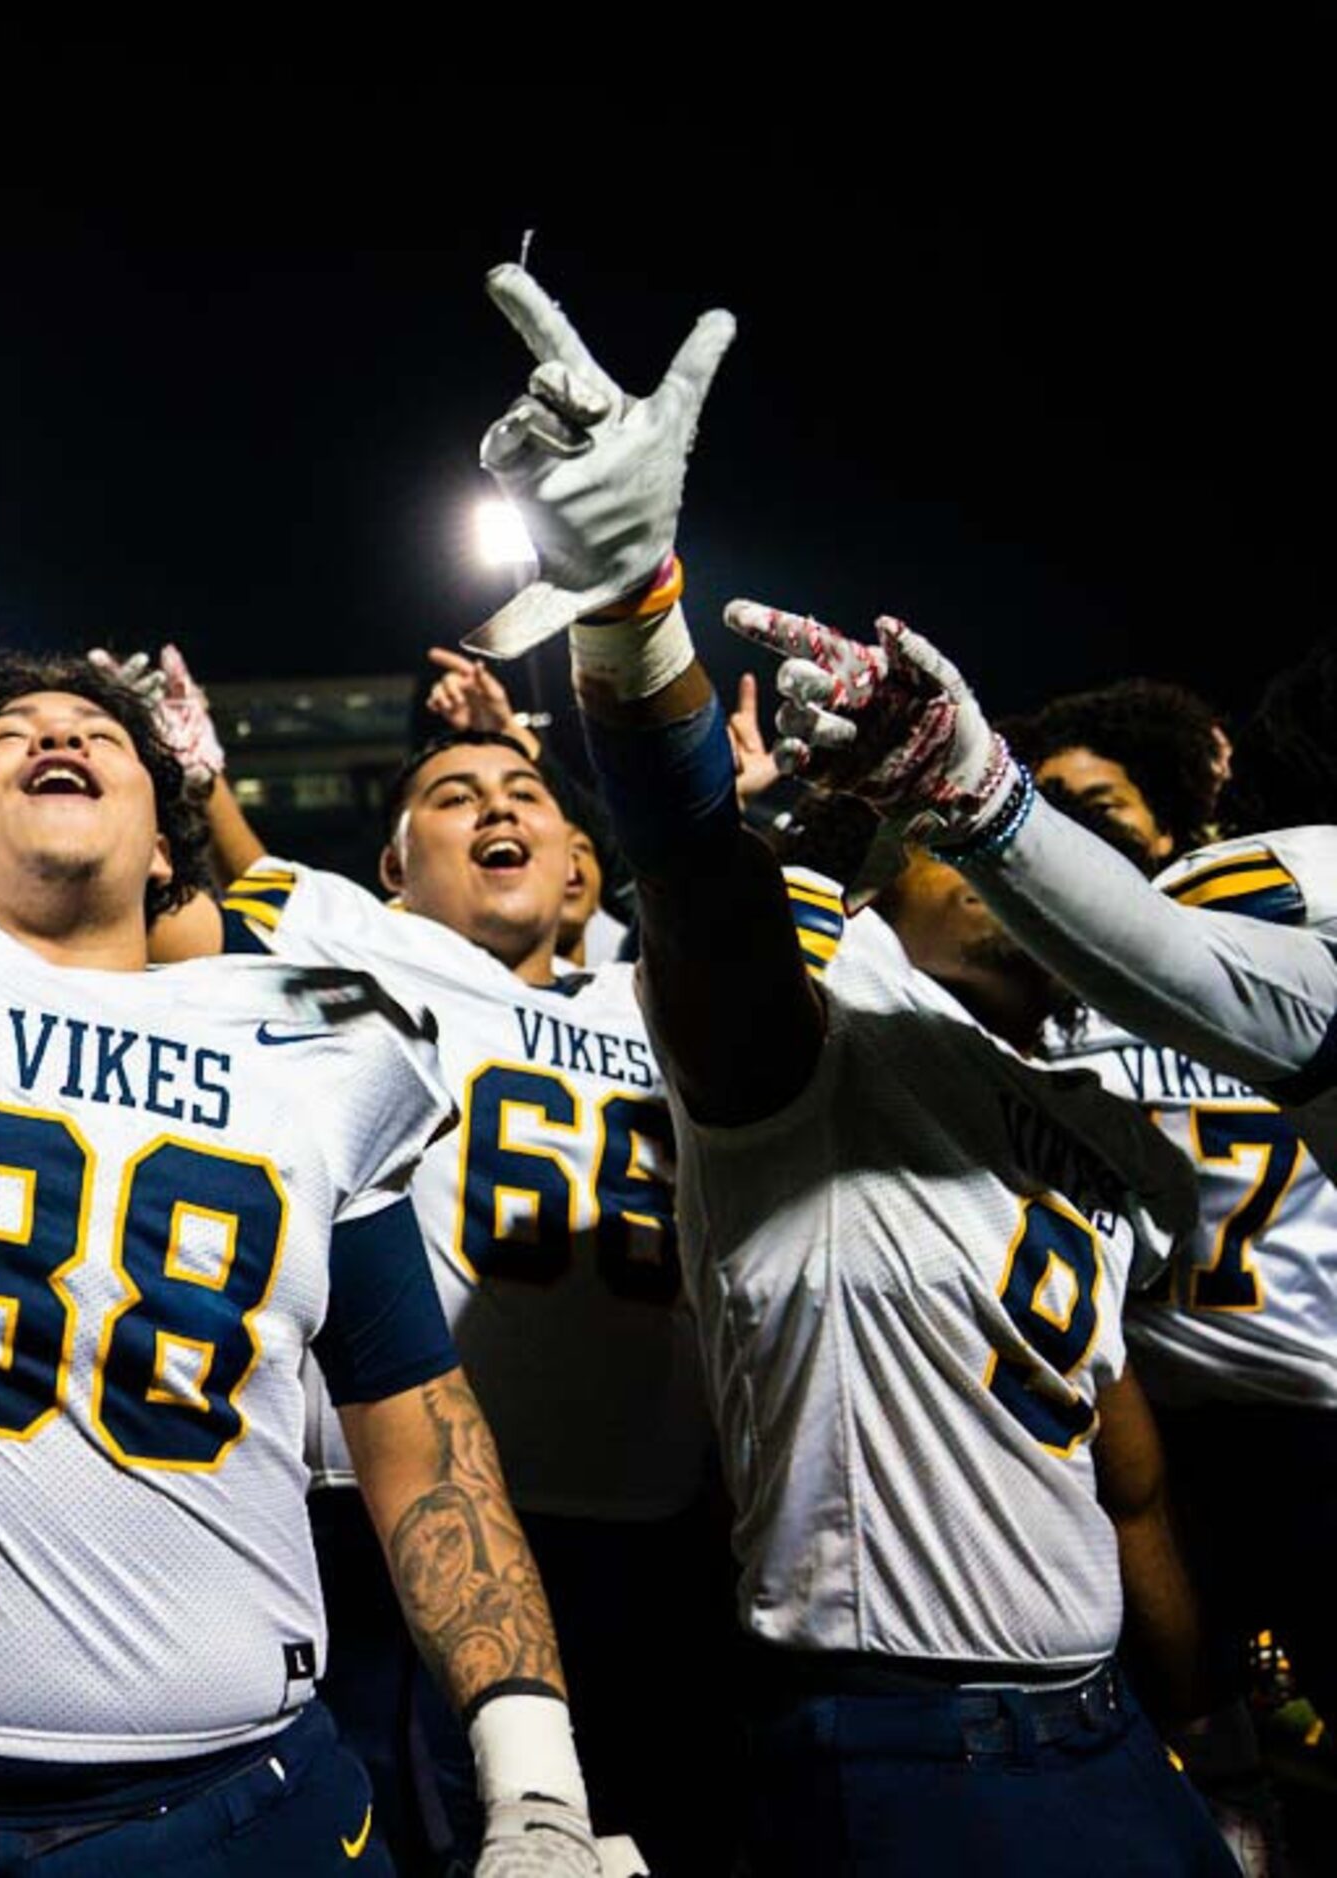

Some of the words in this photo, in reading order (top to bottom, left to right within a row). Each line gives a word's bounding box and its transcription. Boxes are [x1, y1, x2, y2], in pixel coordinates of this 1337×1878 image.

[10, 1008, 231, 1129] VIKES
[514, 1007, 654, 1088] VIKES
[295, 1650, 308, 1672] L
